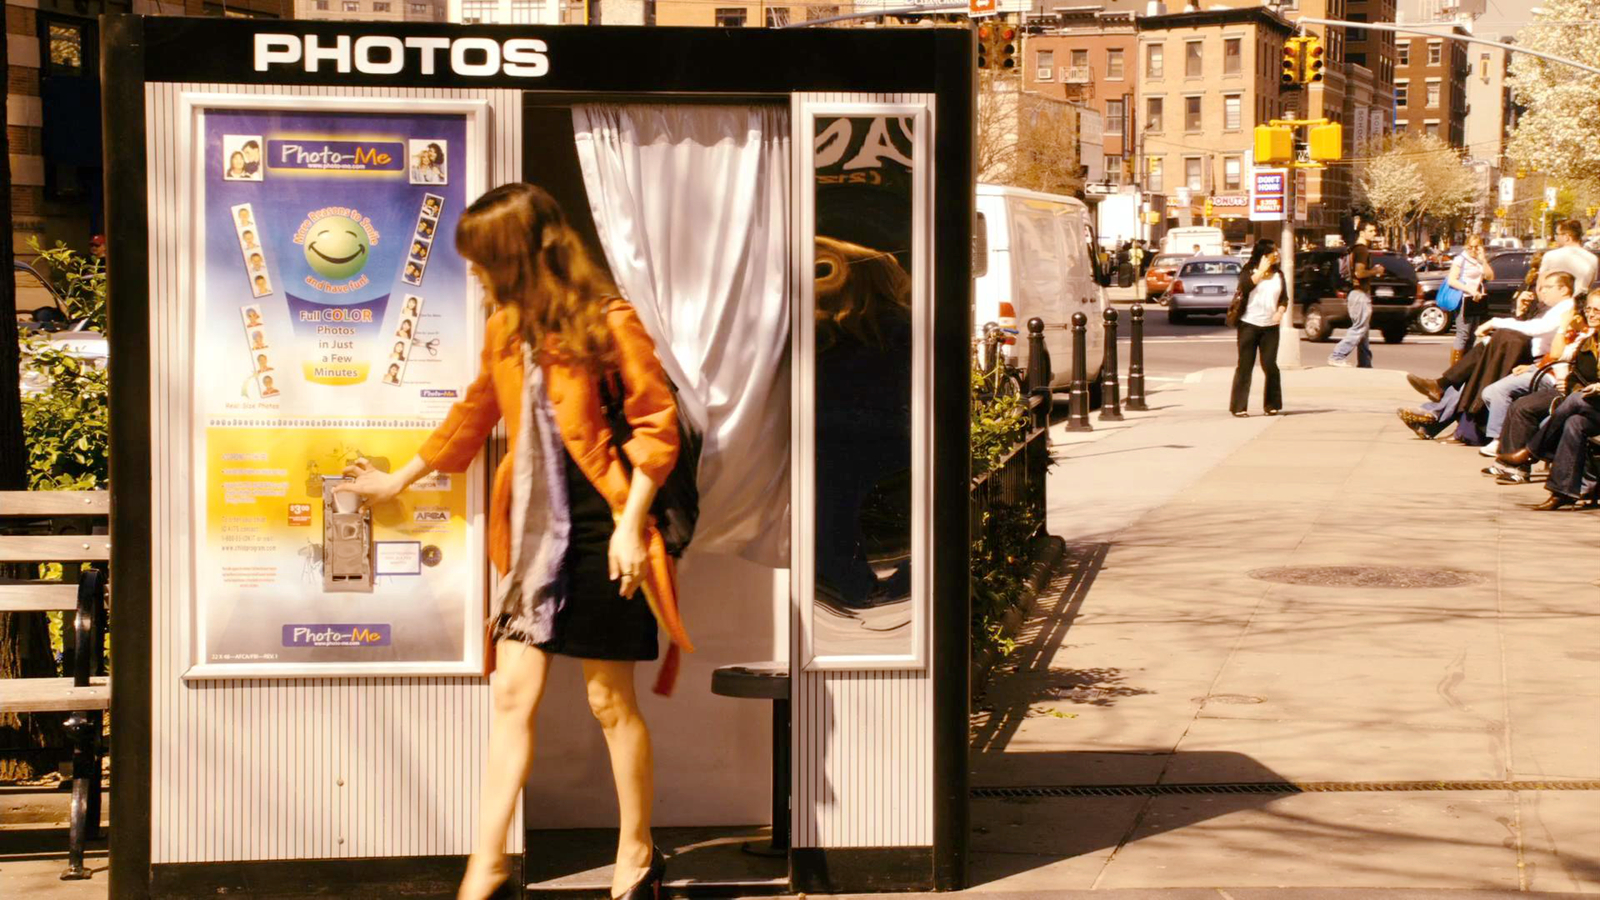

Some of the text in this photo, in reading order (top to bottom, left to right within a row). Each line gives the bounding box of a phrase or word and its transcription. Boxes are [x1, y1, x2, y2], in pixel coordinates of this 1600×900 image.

[254, 33, 549, 77] PHOTOS
[281, 144, 392, 165] Photo-Me
[294, 207, 379, 245] More Reasons to Smile
[305, 276, 324, 290] and
[325, 281, 348, 293] have
[300, 309, 373, 322] Full COLOR
[317, 326, 355, 335] Photos
[319, 340, 353, 349] in Just
[331, 354, 352, 362] Few
[314, 367, 358, 377] Minutes
[293, 627, 382, 643] Photo-Me
